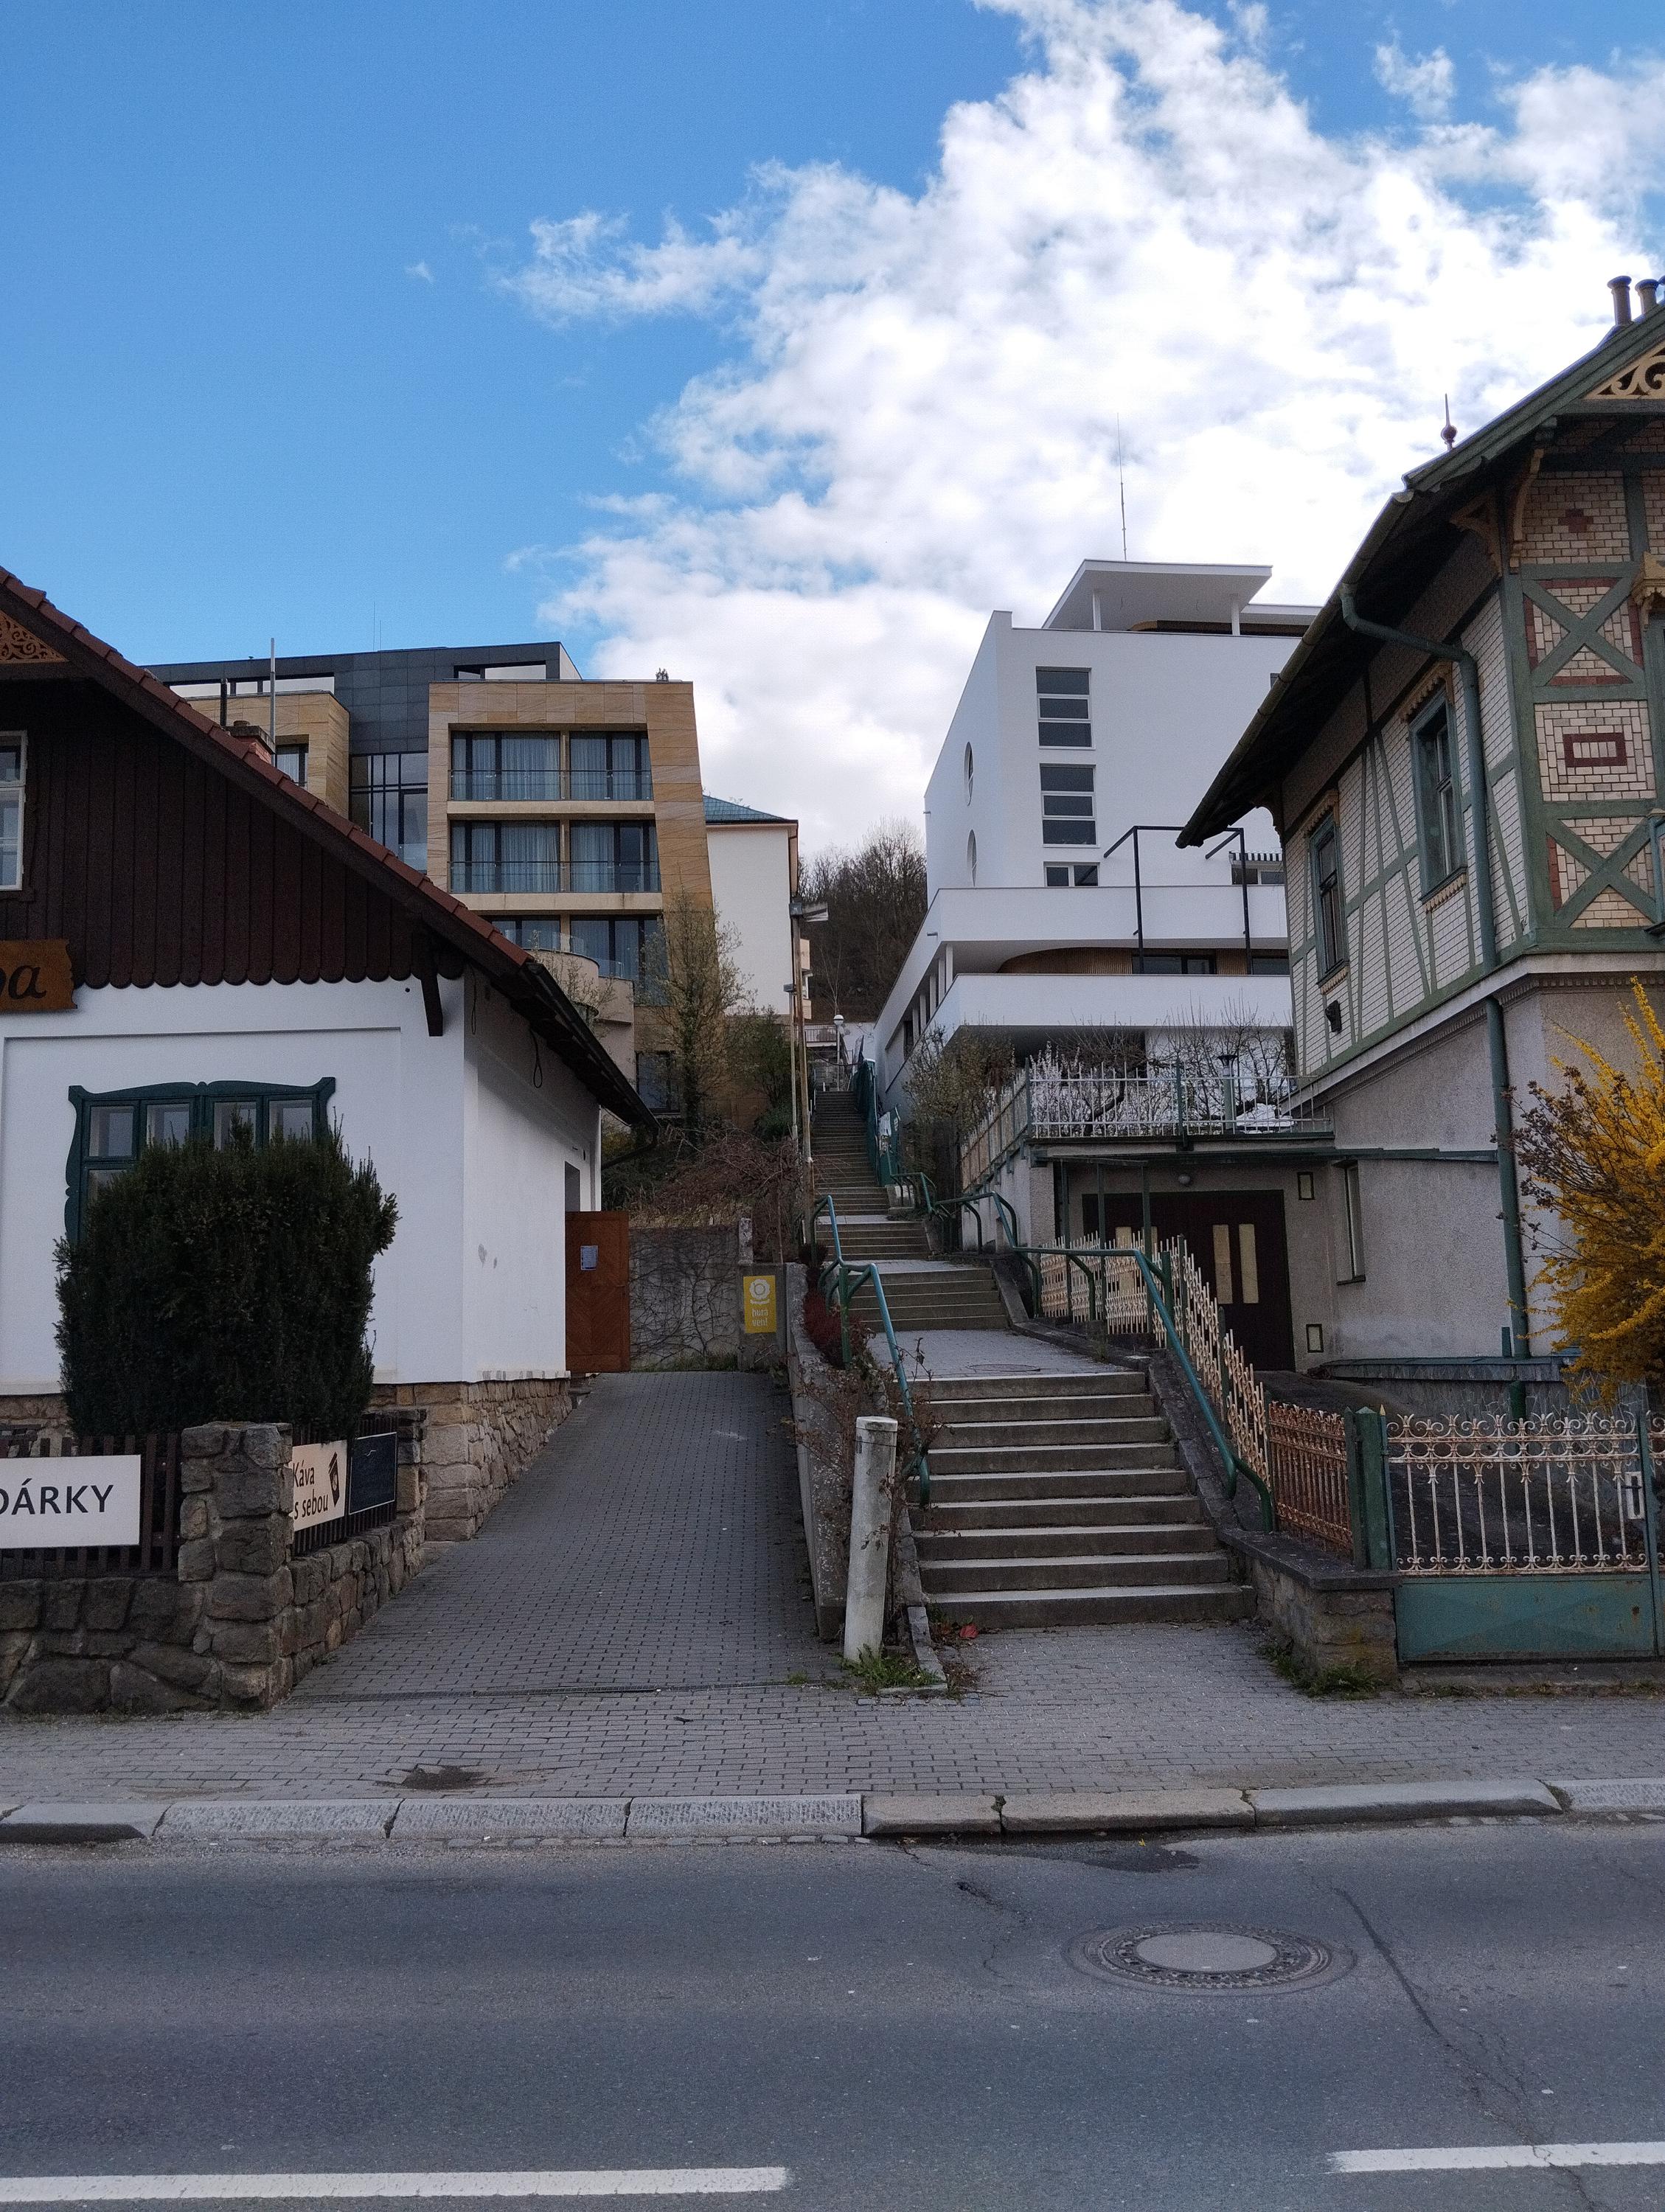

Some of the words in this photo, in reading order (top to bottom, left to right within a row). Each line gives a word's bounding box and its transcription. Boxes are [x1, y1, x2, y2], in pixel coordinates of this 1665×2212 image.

[293, 1460, 315, 1487] Káva
[294, 1501, 299, 1520] s
[302, 1489, 329, 1517] sebou
